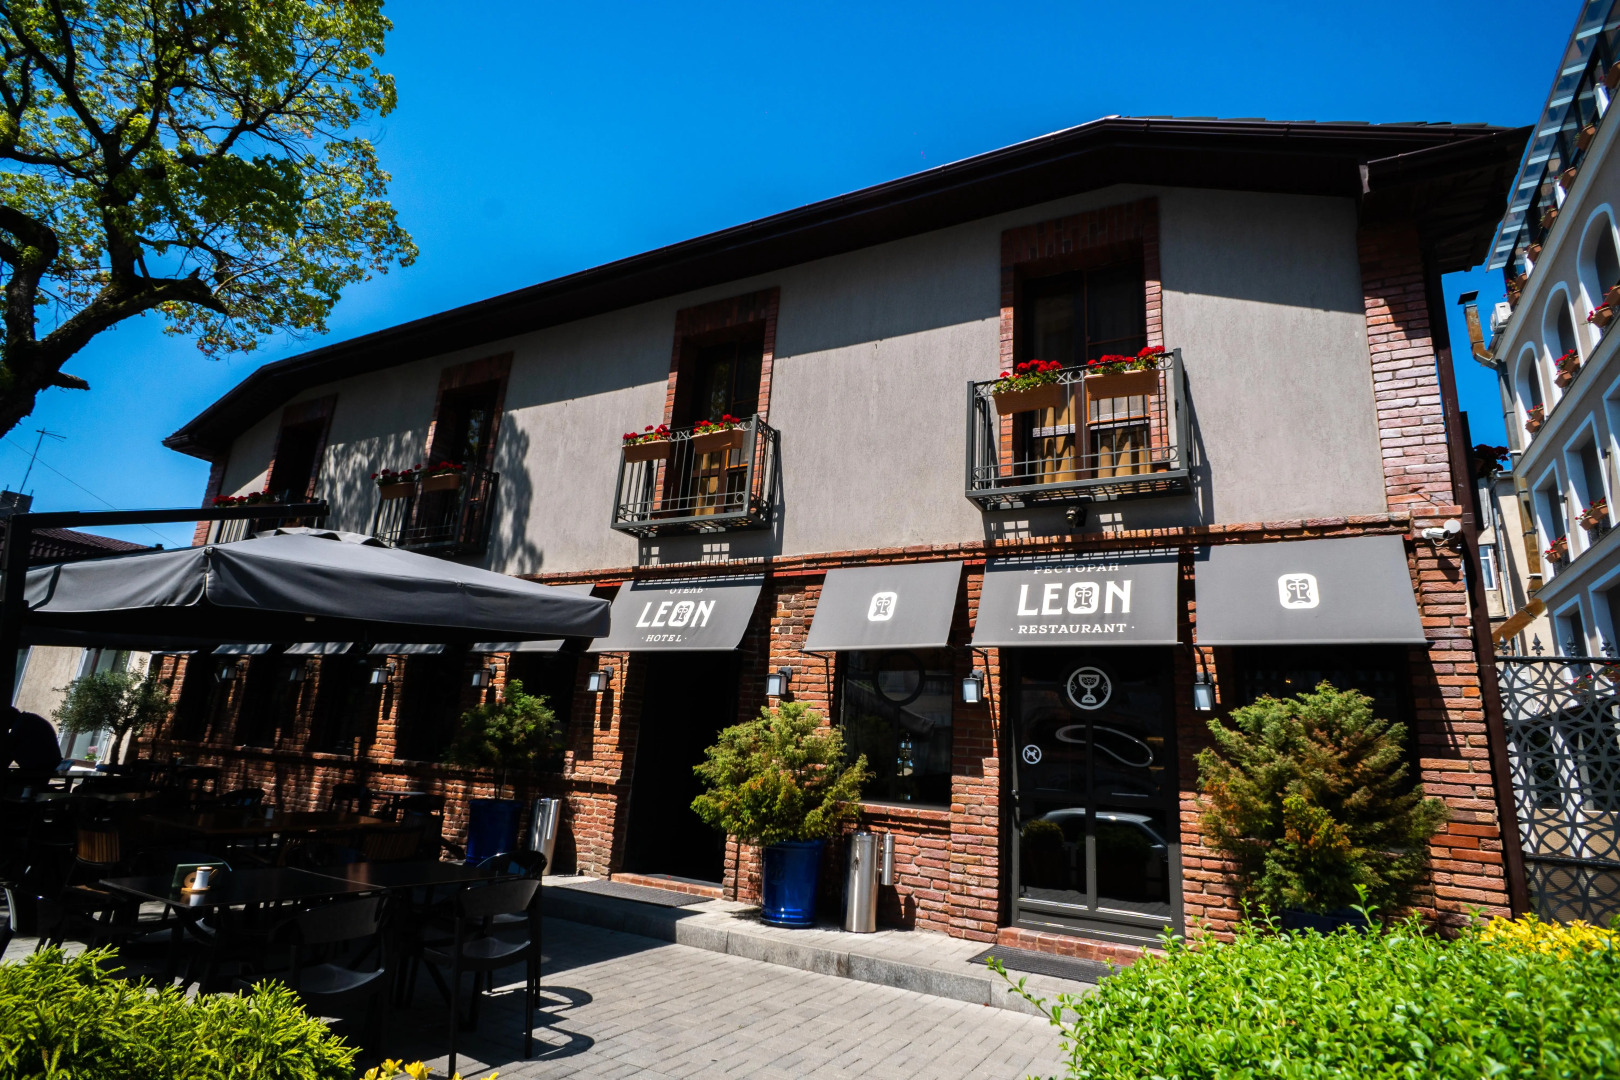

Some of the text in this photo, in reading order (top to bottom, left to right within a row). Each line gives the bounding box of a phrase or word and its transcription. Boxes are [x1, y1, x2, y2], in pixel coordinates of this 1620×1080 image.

[1033, 562, 1120, 575] РЕСТОРАН
[1017, 580, 1132, 616] LEON
[635, 600, 716, 628] LEON
[1018, 623, 1127, 634] RESTAURANT
[645, 634, 682, 642] HOTEL
